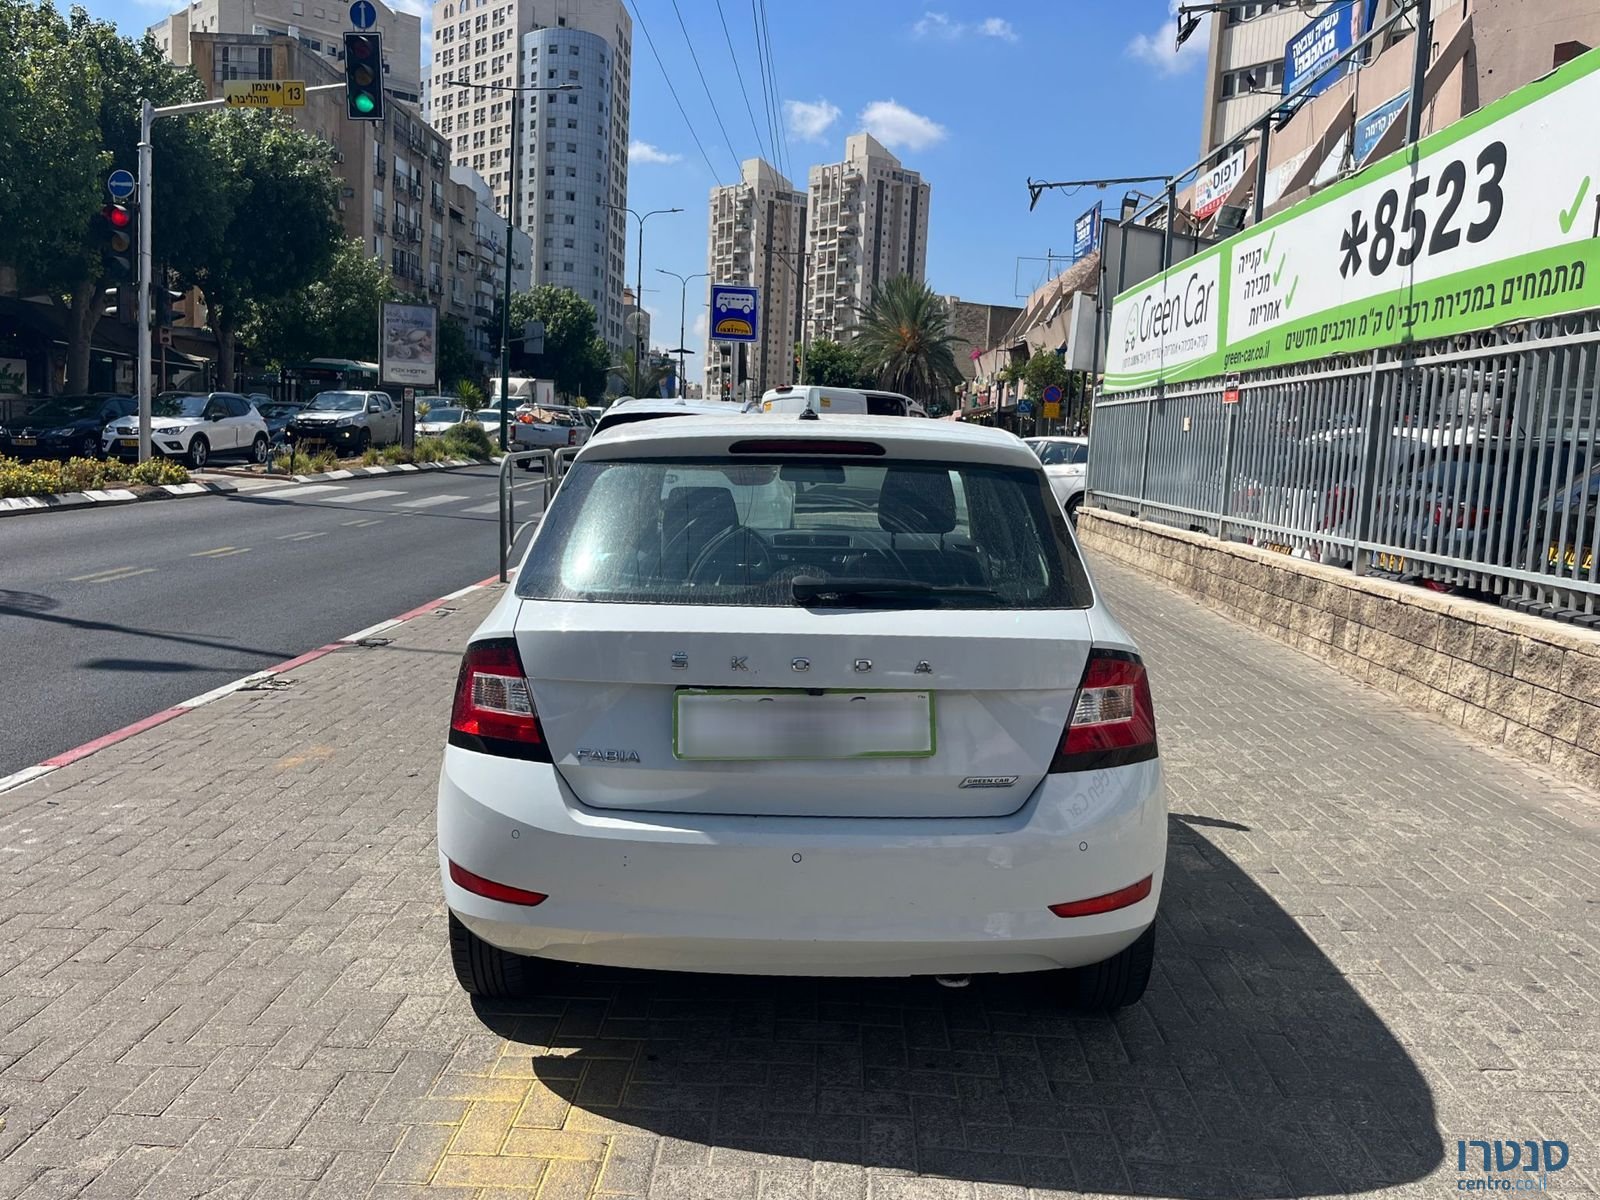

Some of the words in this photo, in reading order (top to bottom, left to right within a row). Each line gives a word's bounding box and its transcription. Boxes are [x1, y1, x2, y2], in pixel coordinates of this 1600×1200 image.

[252, 83, 275, 94] ויצמן
[287, 87, 301, 100] 13
[1213, 159, 1239, 189] דפוס
[1238, 248, 1262, 274] קנייה
[1244, 273, 1271, 300] מכירה
[1501, 260, 1585, 305] מתמחים
[1140, 294, 1181, 342] Green
[1184, 272, 1215, 328] Car
[1249, 298, 1282, 326] אחריות
[1398, 300, 1429, 328] רכבי
[1431, 283, 1495, 322] במכירת
[1285, 326, 1318, 351] חדשים
[1320, 317, 1356, 343] ורכבים
[1224, 340, 1270, 370] green-car.co.il
[577, 749, 641, 763] FABIA
